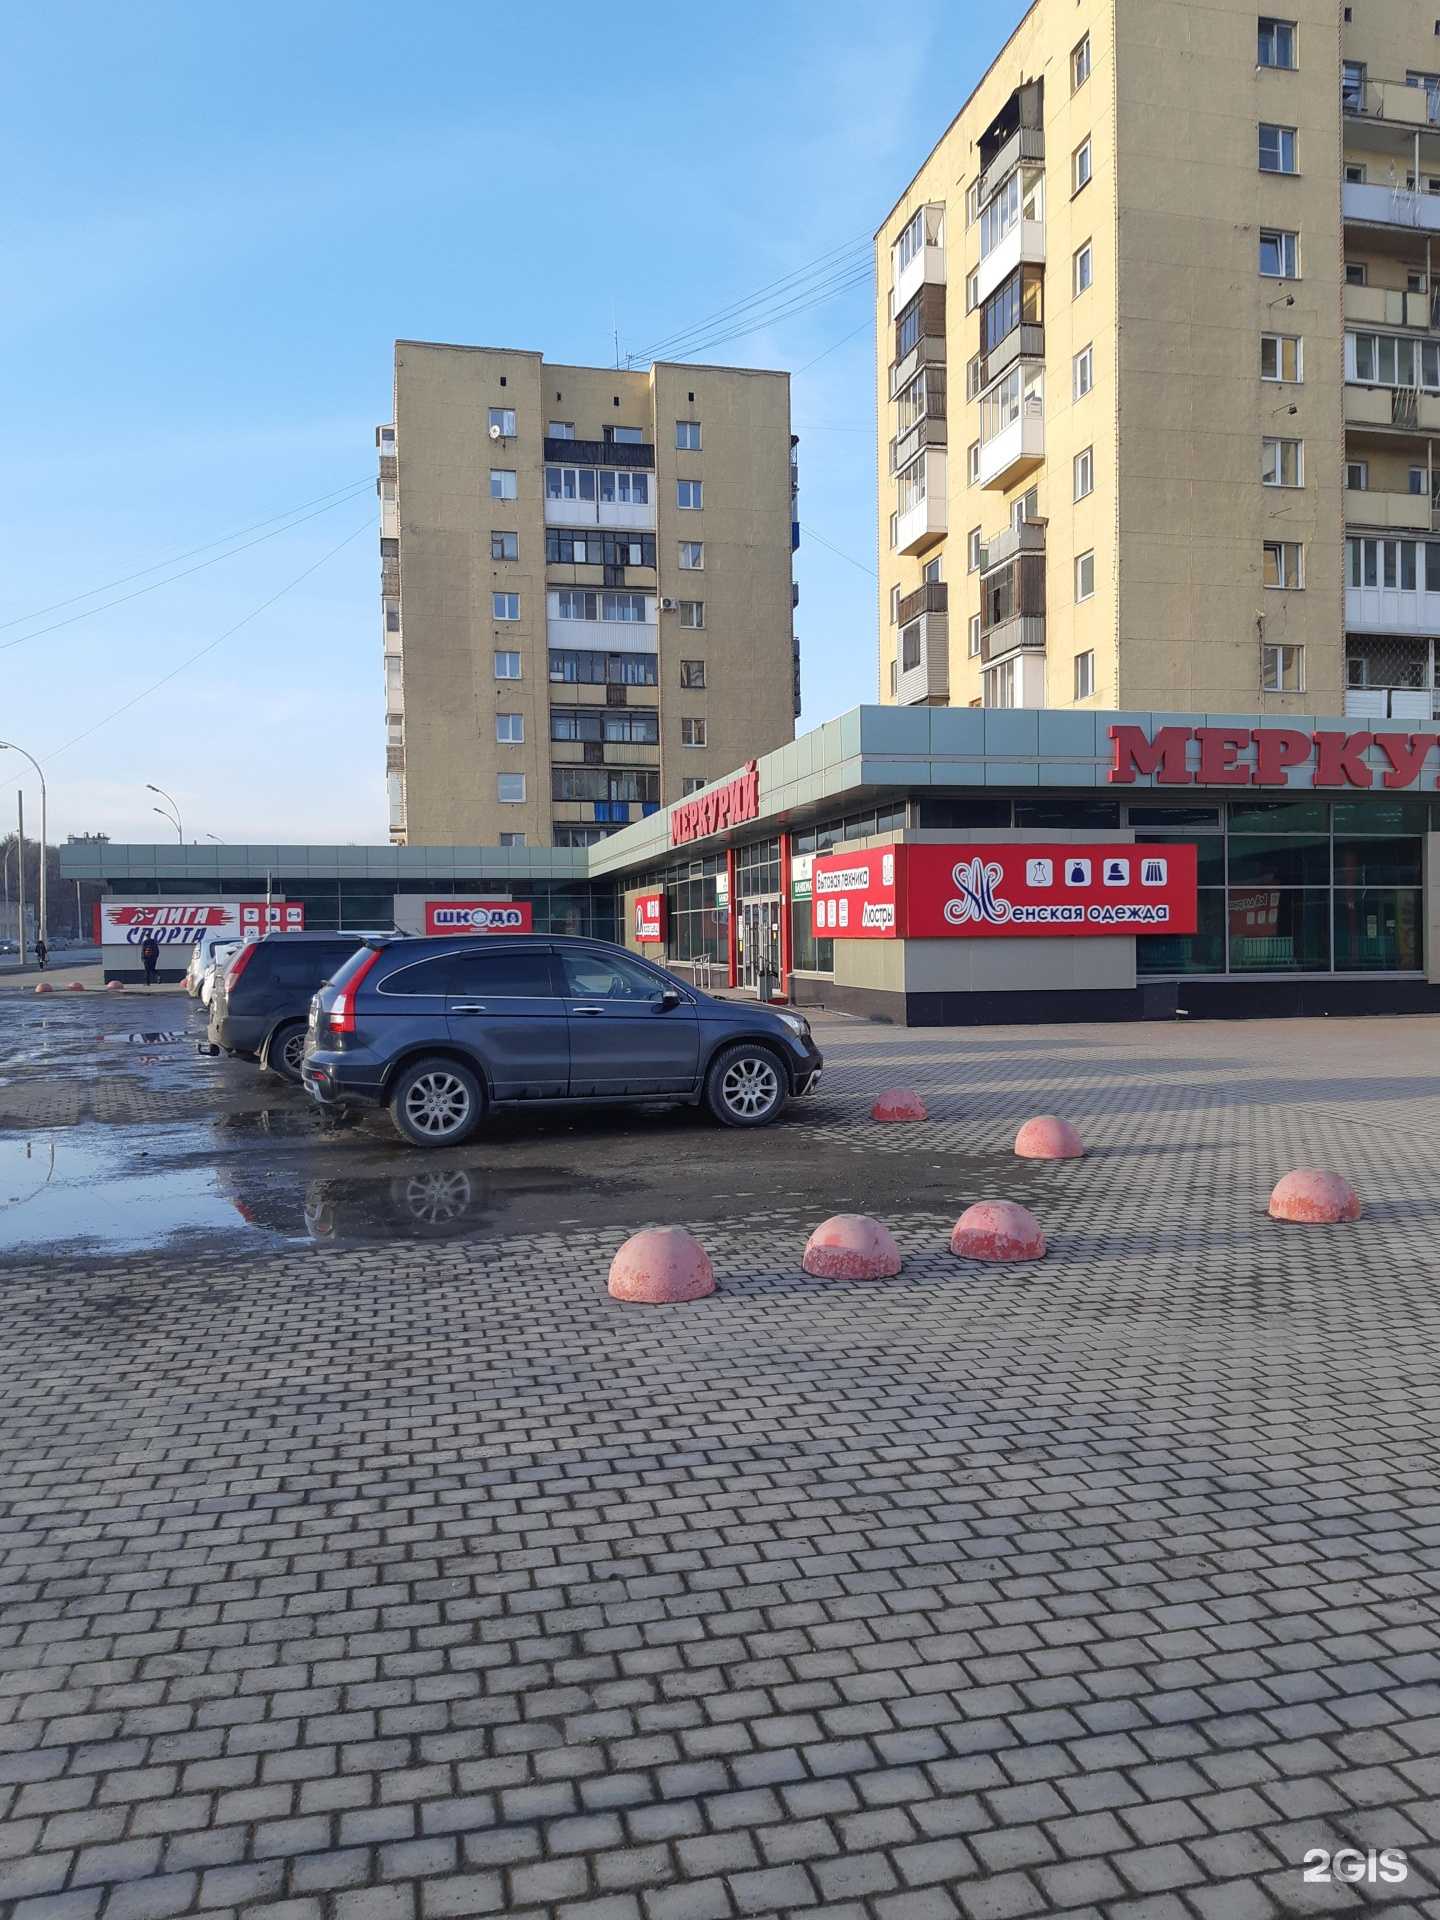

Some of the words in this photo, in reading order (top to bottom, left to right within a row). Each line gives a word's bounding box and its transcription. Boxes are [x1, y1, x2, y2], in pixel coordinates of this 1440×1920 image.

[1108, 725, 1440, 788] МЕРКУ
[671, 759, 760, 846] МЕРКУРИЙ
[816, 872, 841, 891] Бытовая
[841, 869, 868, 888] техника
[152, 907, 208, 925] ЛИГА
[862, 903, 894, 928] Люстры
[1089, 906, 1168, 922] одежда
